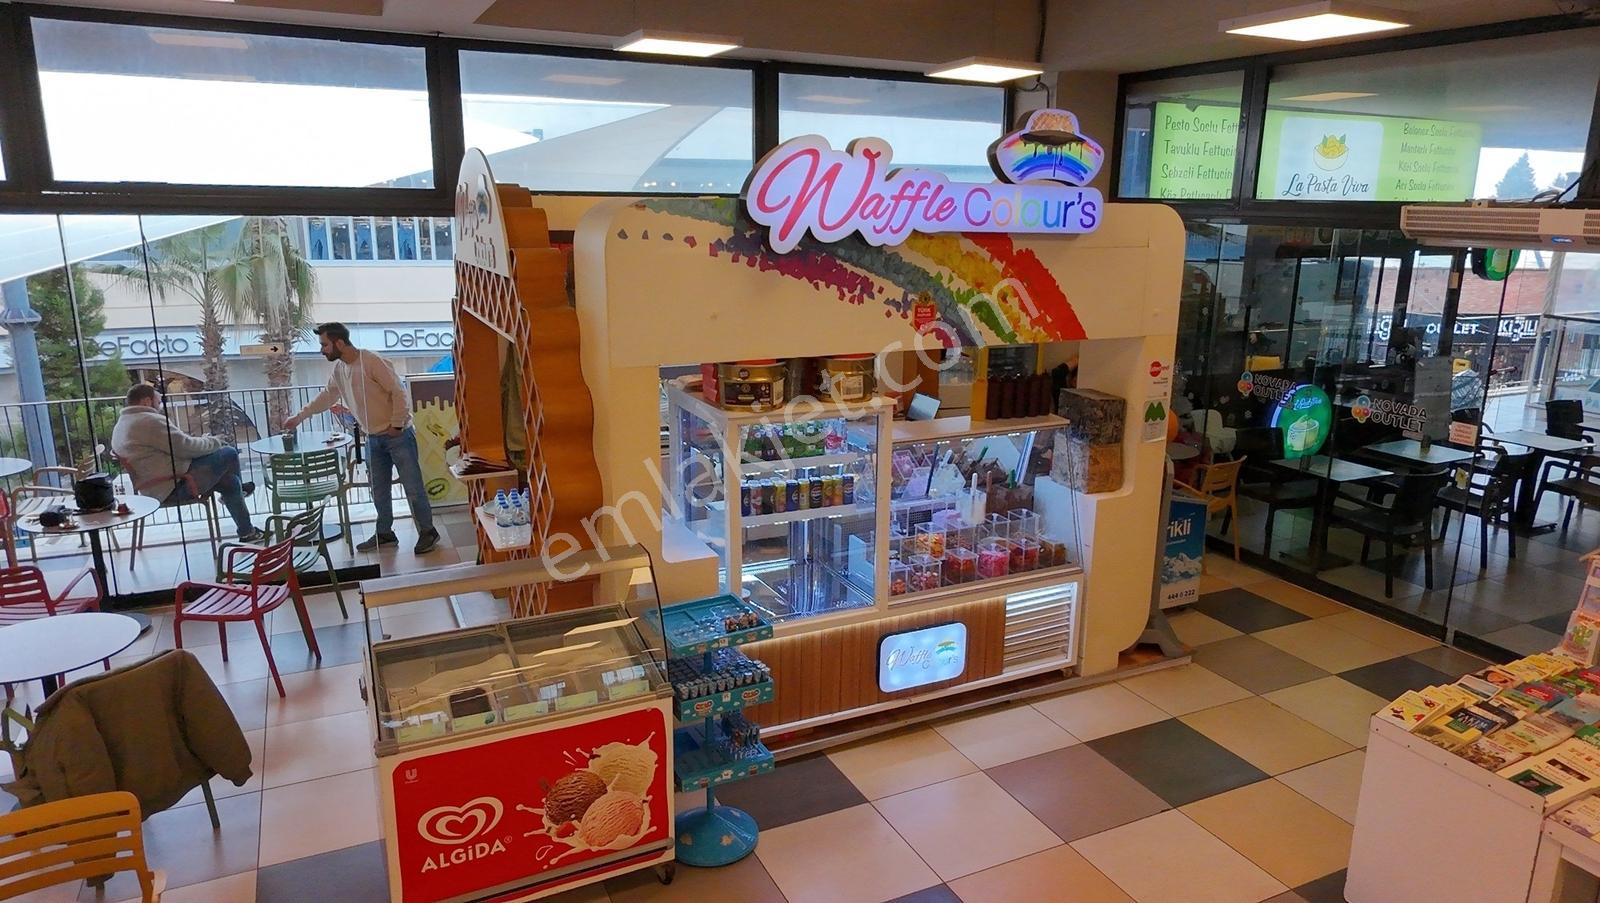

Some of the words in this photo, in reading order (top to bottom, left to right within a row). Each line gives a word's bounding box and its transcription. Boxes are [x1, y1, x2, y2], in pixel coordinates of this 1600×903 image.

[1165, 115, 1190, 131] Pesto
[1192, 117, 1218, 133] Soslu
[1221, 119, 1240, 134] Fett
[1164, 140, 1199, 156] Tavuklu
[1203, 141, 1234, 157] Fettuci
[1161, 163, 1194, 179] Sebzeli
[1197, 165, 1233, 180] Fettucin
[1281, 173, 1304, 197] La
[1307, 173, 1338, 194] Pasta
[1341, 174, 1369, 196] Viva
[757, 147, 957, 243] Waffle
[963, 187, 1097, 229] Colour's
[384, 329, 453, 348] DeFac
[1426, 323, 1479, 335] OLET
[1254, 374, 1297, 390] NOVADA
[1373, 398, 1428, 419] NOVADA
[1370, 412, 1427, 434] OUTLET
